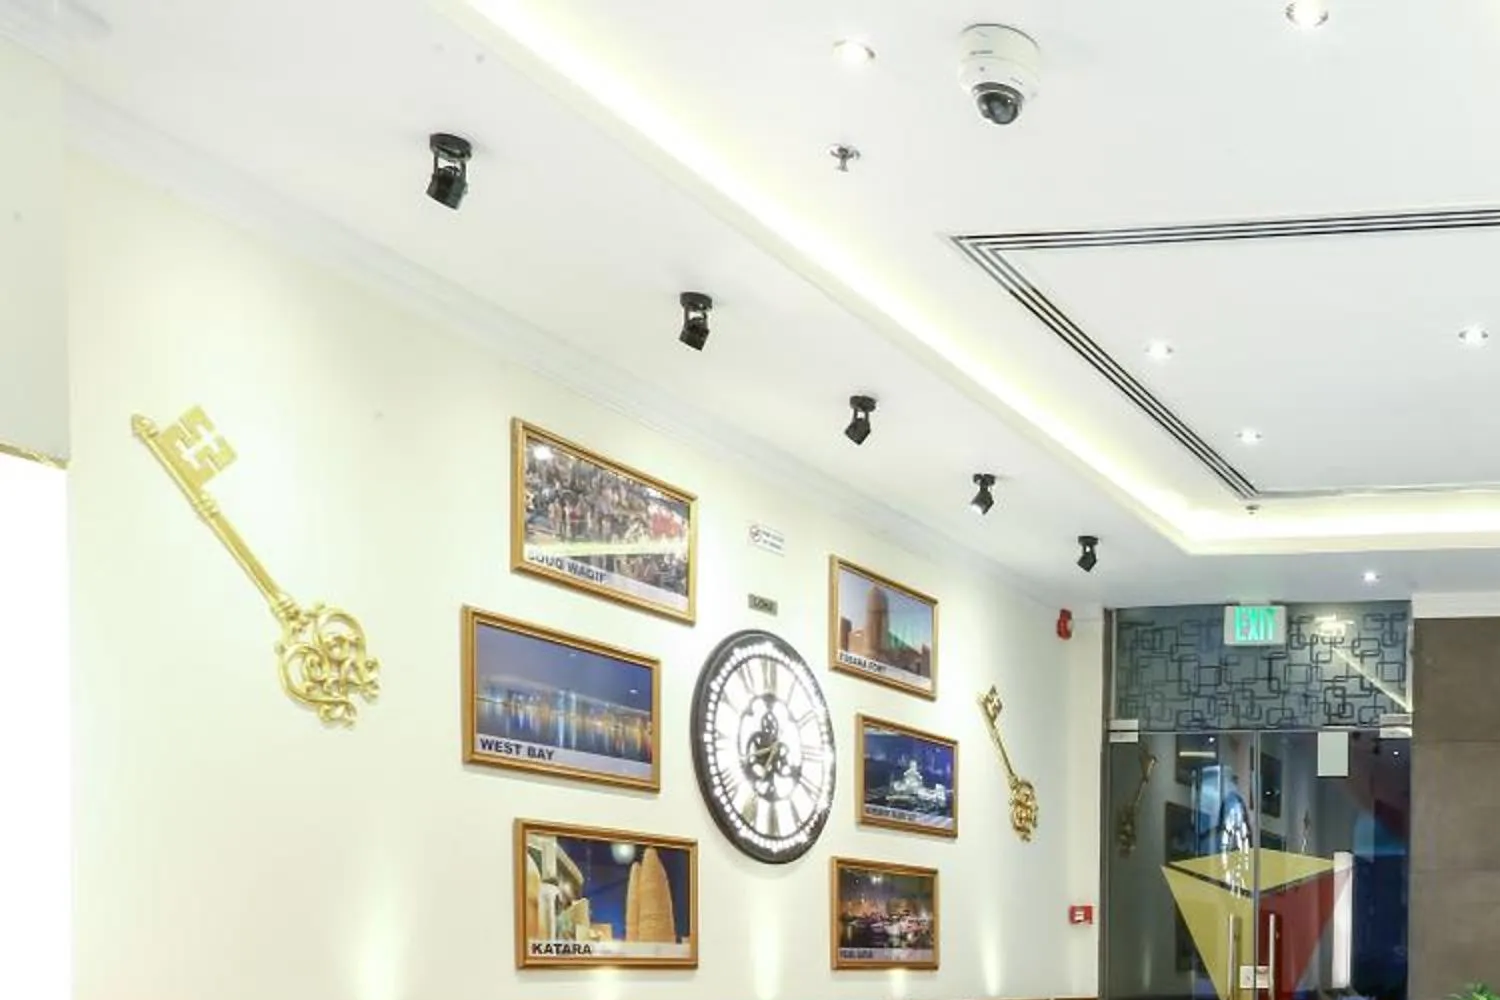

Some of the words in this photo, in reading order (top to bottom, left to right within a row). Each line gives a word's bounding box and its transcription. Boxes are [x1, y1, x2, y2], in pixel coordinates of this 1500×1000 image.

[1234, 608, 1278, 641] EXIT
[480, 739, 522, 756] WEST
[527, 745, 555, 761] BAY
[531, 943, 592, 955] KATARA
